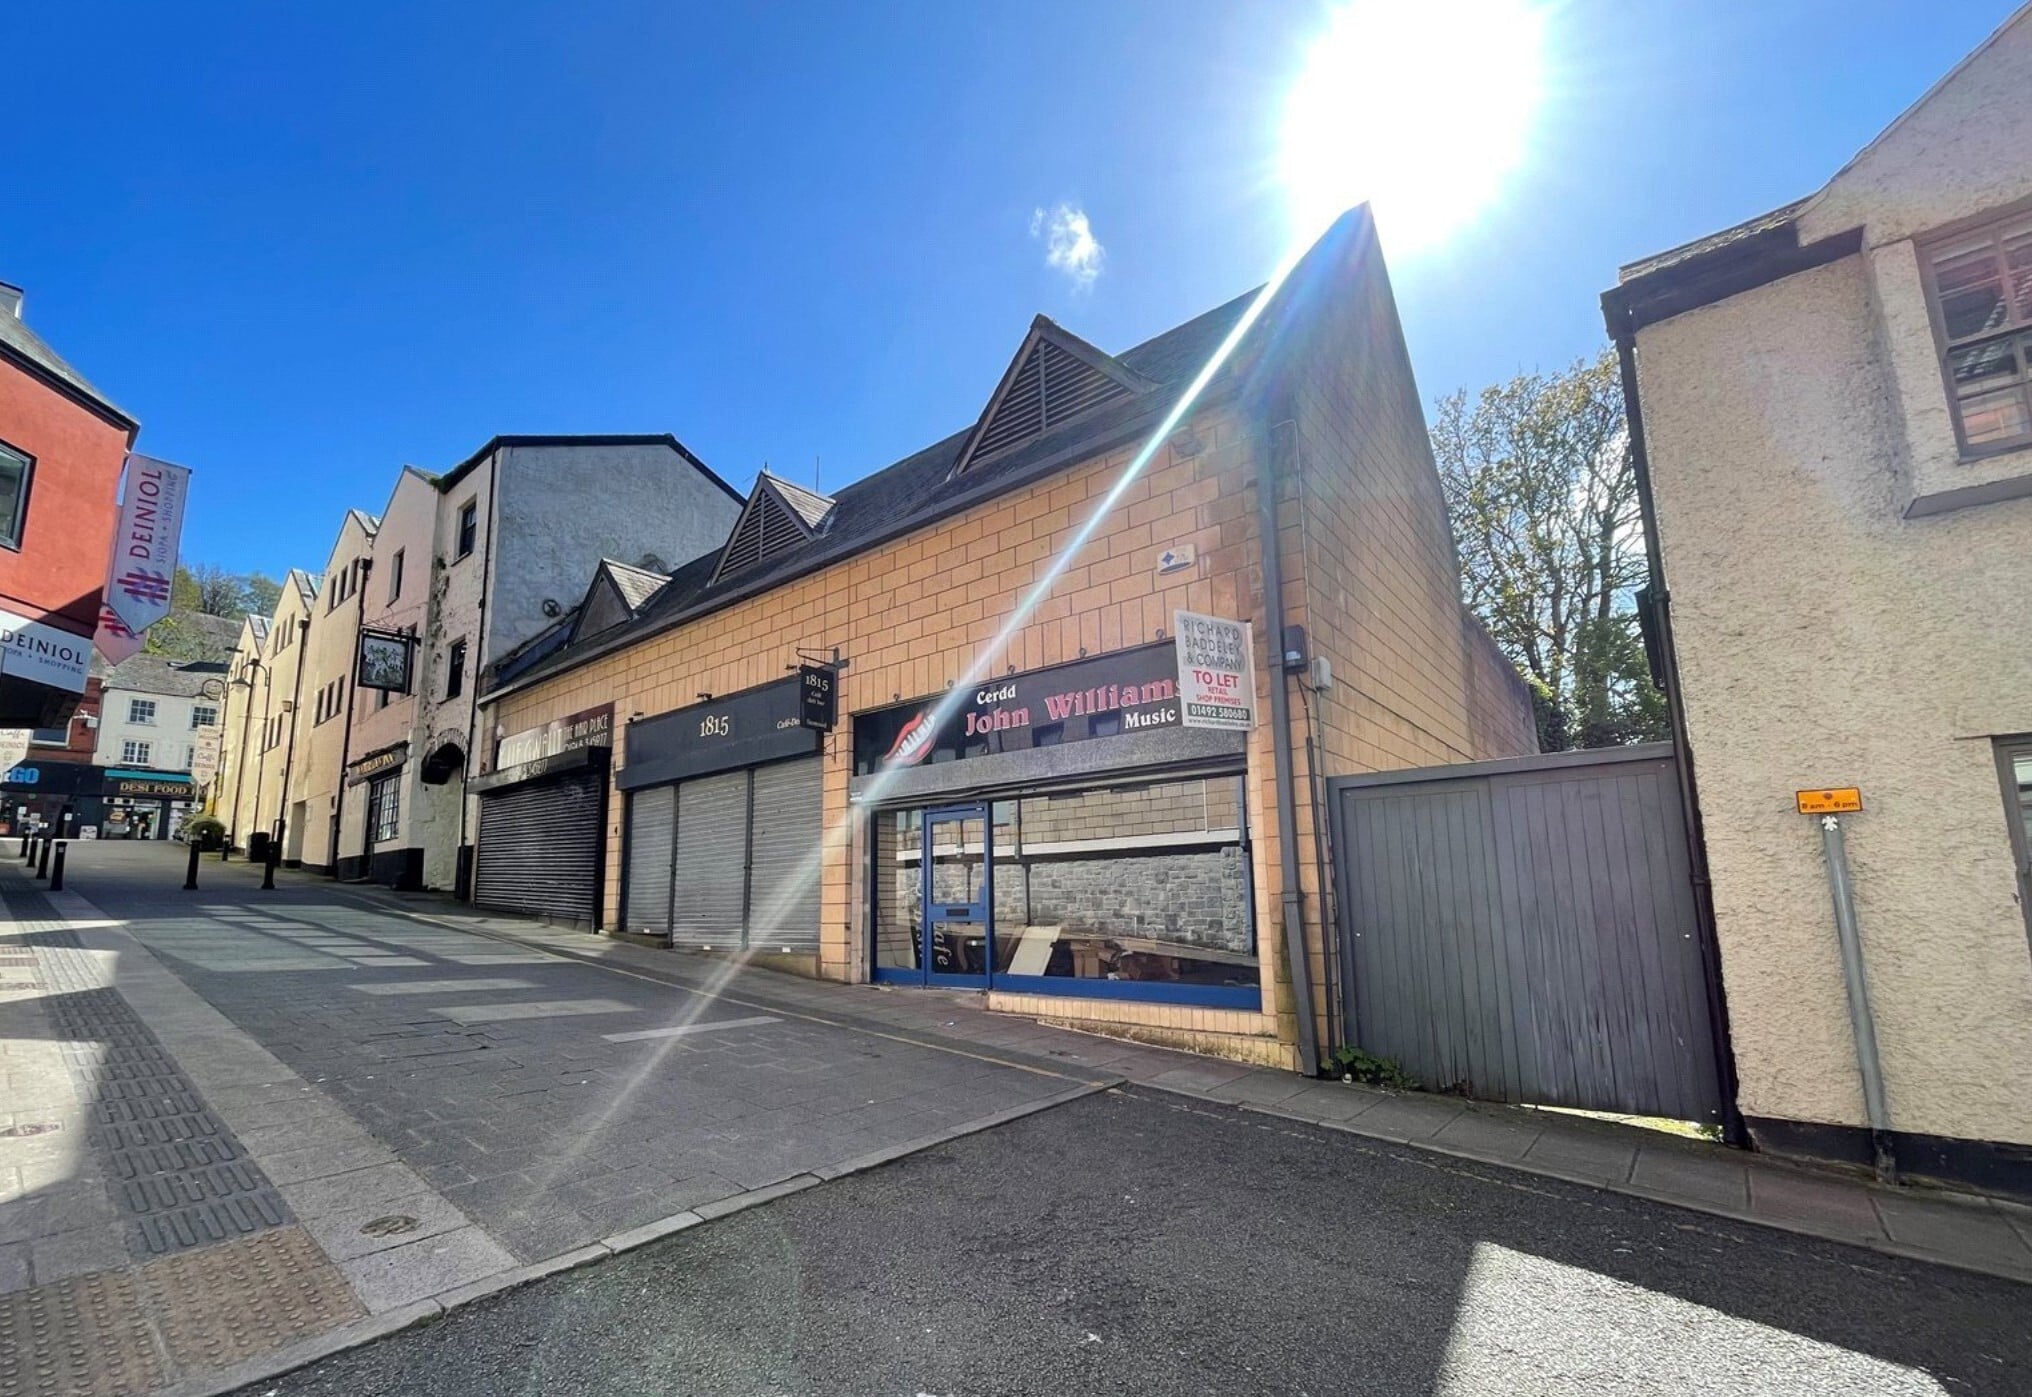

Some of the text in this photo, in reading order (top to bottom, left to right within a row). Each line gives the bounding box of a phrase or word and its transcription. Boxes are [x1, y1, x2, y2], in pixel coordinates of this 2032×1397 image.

[129, 470, 162, 560] DEINIOL
[1183, 618, 1240, 640] RICHARD
[1, 628, 84, 665] DEINIOL
[1184, 634, 1241, 655] BADDELEY
[7, 647, 22, 657] OPA
[39, 656, 82, 674] SHOPPING
[1187, 651, 1242, 671] & COMPANY
[805, 674, 829, 692] 1815
[1192, 670, 1239, 688] TO LET
[976, 684, 1016, 705] Cerdd
[1196, 694, 1212, 702] SHOP
[1207, 686, 1228, 695] RETAIL
[1124, 708, 1177, 729] Music
[1191, 704, 1217, 717] 01492
[700, 715, 729, 737] 1815
[965, 707, 1030, 737] John
[153, 785, 187, 795] FOOD
